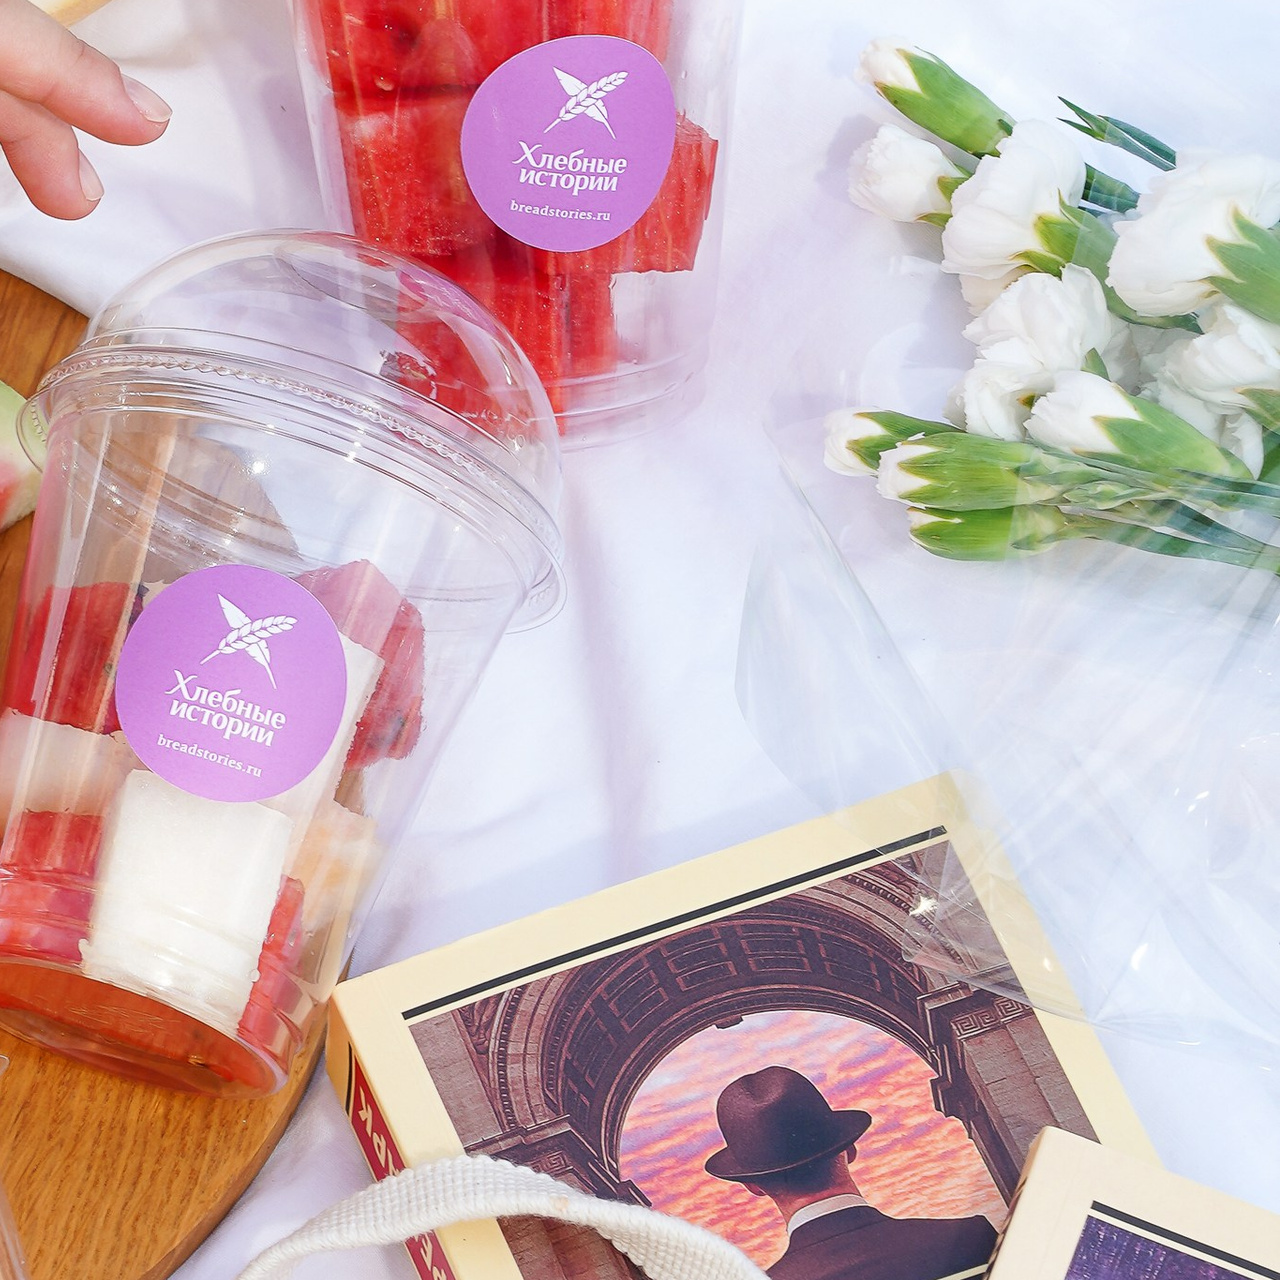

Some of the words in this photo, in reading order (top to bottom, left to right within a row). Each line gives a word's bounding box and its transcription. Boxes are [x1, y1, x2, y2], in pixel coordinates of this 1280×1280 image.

[512, 141, 628, 174] Хлебные
[518, 168, 619, 196] истории
[510, 200, 611, 221] breadstories.ru
[165, 669, 287, 730] Хлебные
[170, 699, 275, 747] истории
[157, 734, 263, 778] breadstories.ru
